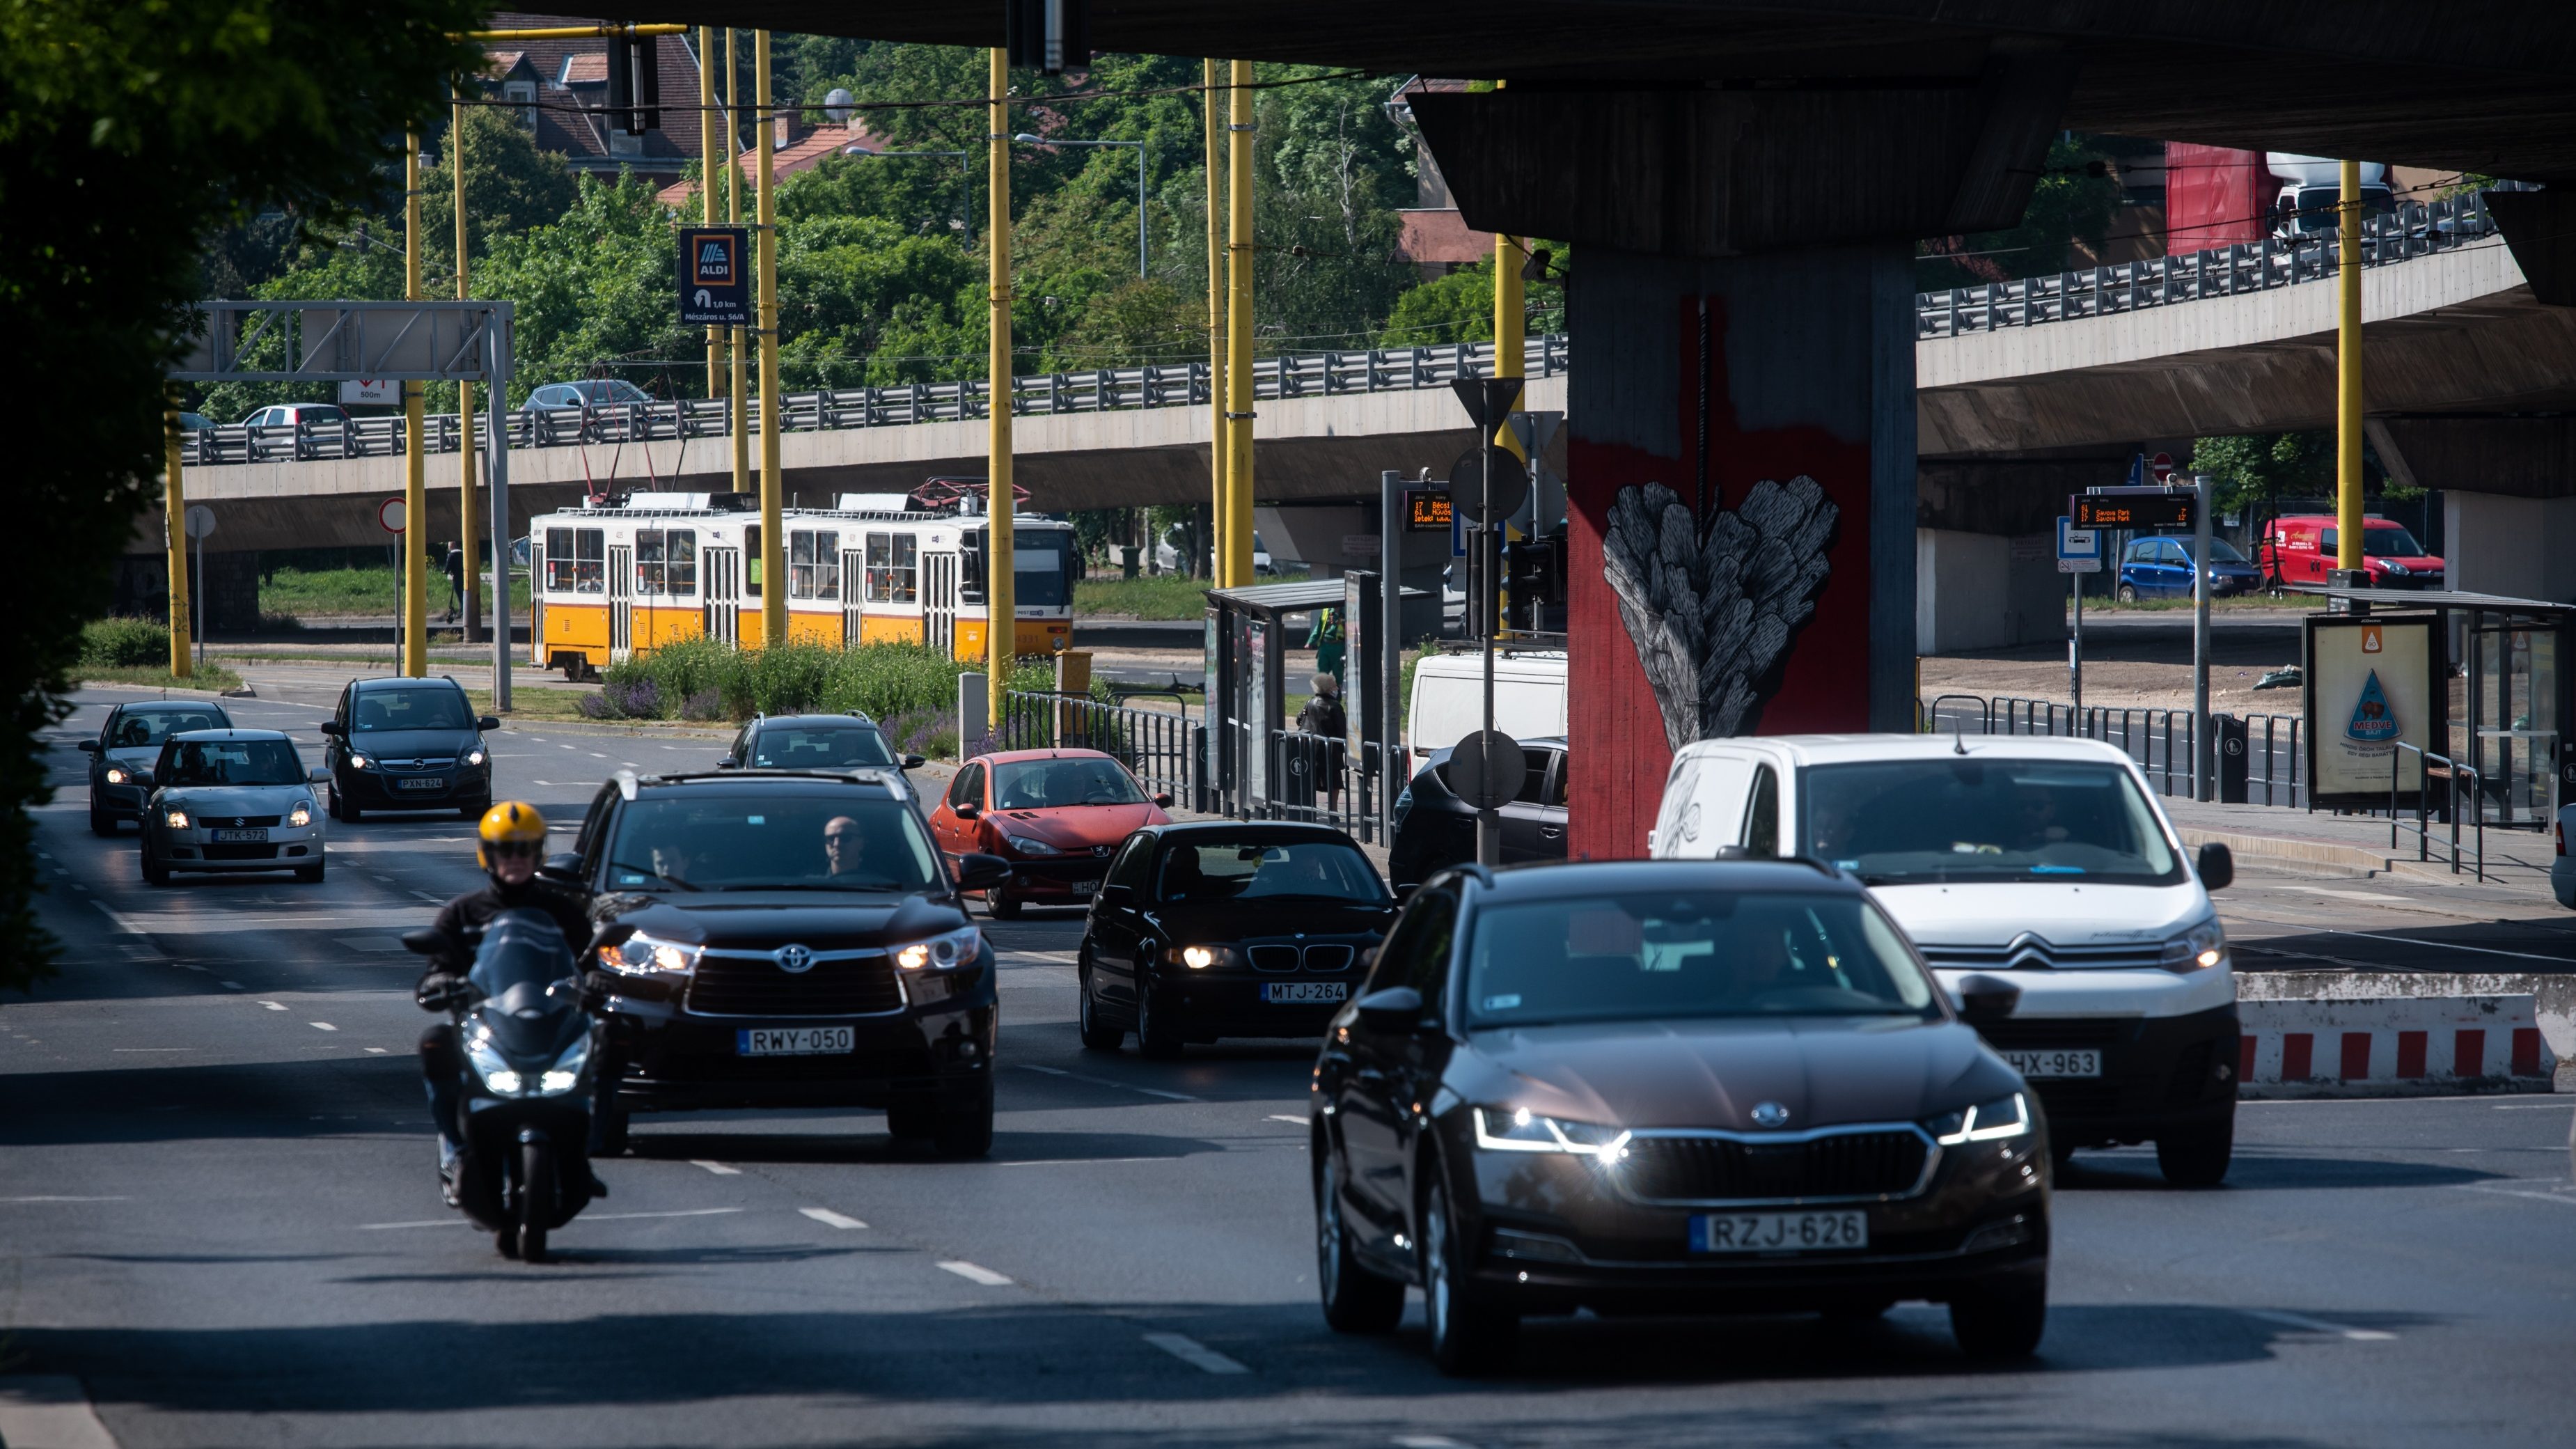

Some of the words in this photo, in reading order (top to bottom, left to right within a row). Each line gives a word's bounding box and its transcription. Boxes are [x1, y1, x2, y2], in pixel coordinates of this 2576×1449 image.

[700, 265, 728, 275] ALDI
[2354, 721, 2392, 730] MEDVE
[403, 779, 441, 788] PXN-624
[220, 831, 265, 840] JTK-572
[1081, 882, 1097, 892] HO
[1271, 984, 1344, 999] MTJ-264
[753, 1029, 849, 1051] RWY-050
[2005, 1052, 2095, 1074] HX-963
[1713, 1214, 1861, 1248] RZJ-626
